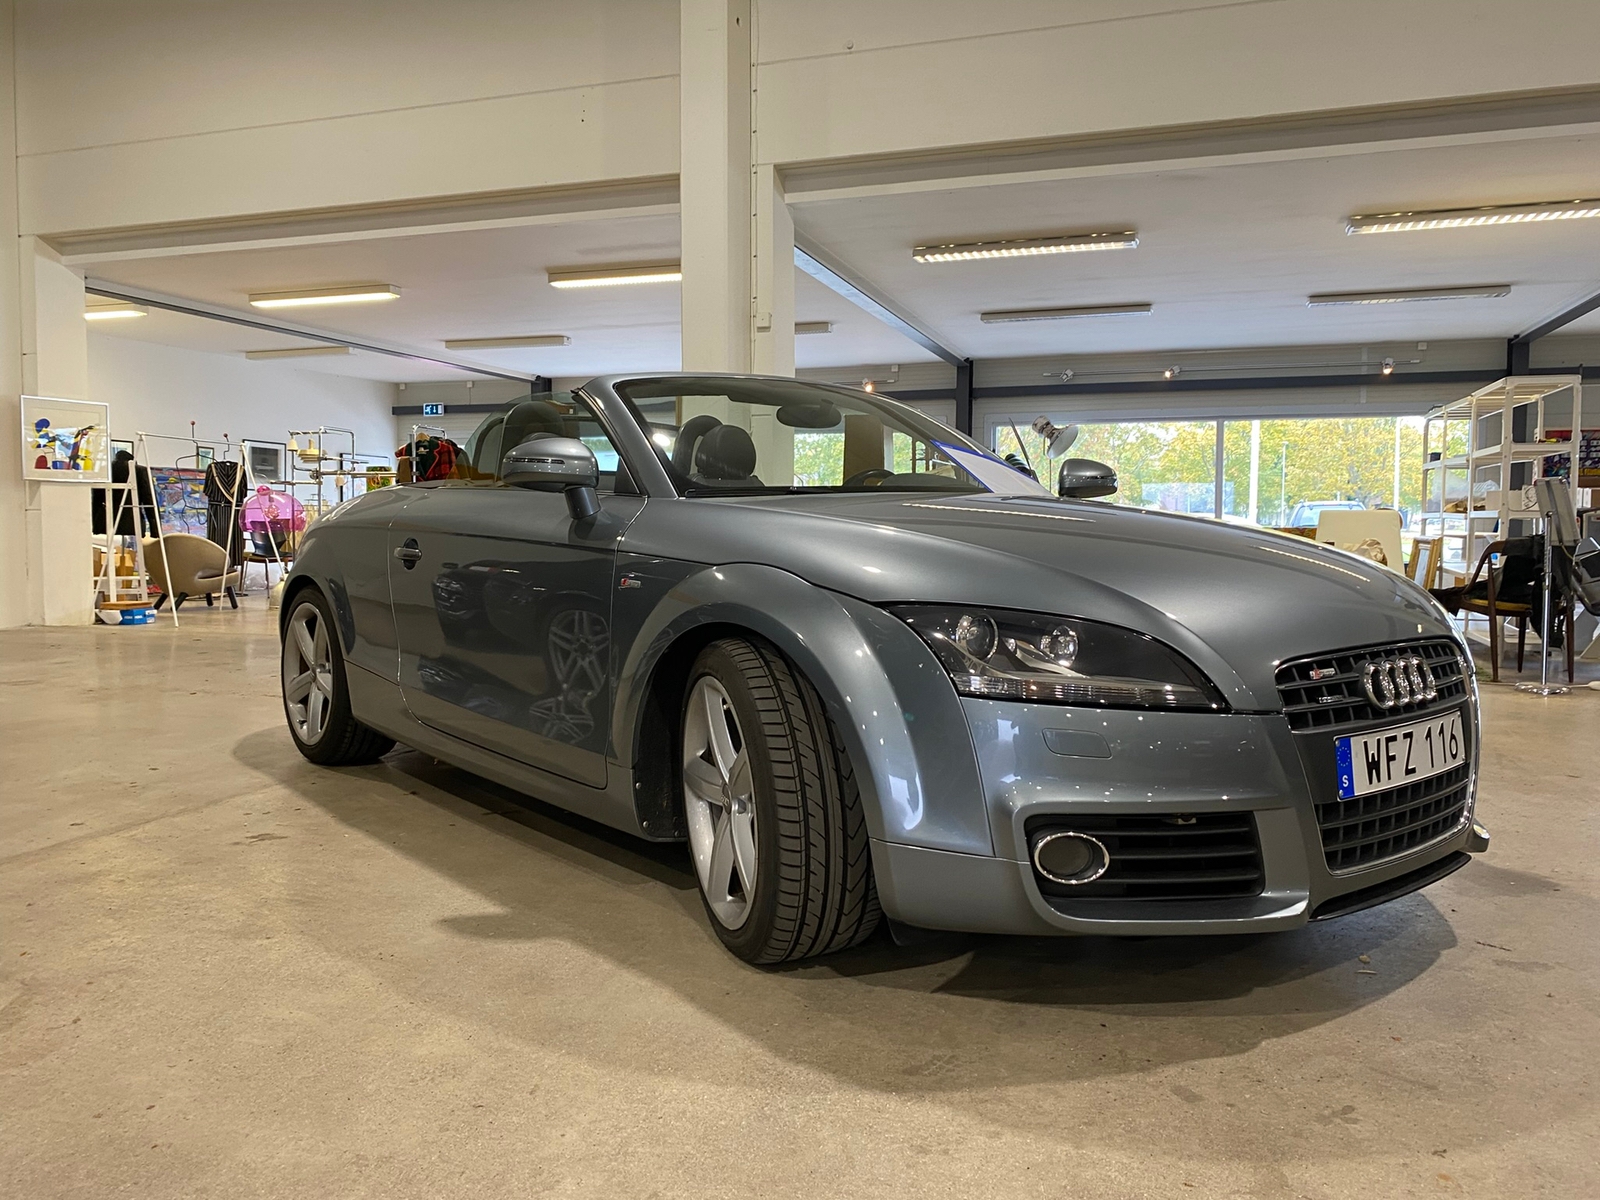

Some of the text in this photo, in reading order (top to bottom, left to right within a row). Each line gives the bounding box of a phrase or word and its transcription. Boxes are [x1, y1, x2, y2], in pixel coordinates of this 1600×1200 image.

[1362, 717, 1459, 785] WFZ 116
[1342, 775, 1349, 787] S
